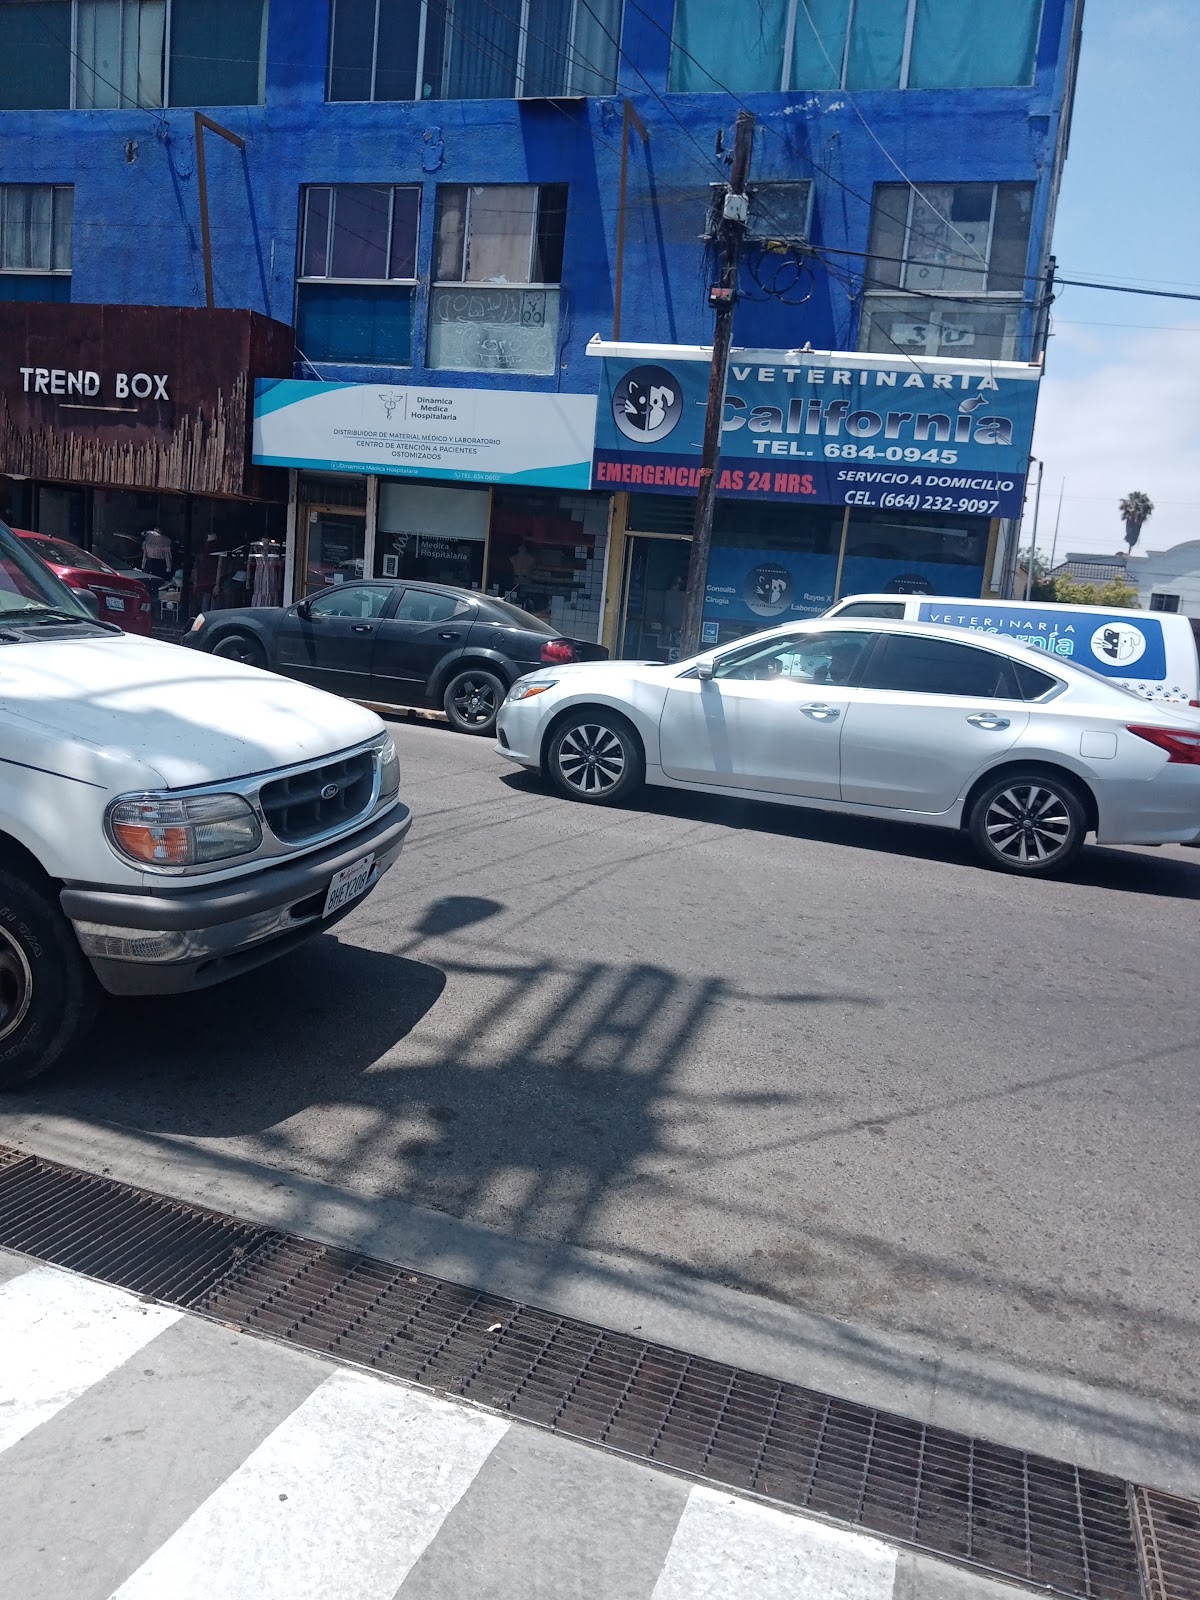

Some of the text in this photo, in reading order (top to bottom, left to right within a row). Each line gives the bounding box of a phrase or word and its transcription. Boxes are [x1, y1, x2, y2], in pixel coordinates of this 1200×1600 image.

[19, 367, 170, 401] TREND BOX
[731, 366, 1000, 391] VETERINARIA
[411, 411, 457, 421] Hospitalaria
[420, 404, 448, 412] Medica
[333, 428, 378, 438] DISTRIBUIDOR
[389, 432, 420, 440] MATERIAL
[421, 434, 448, 442] MÉDICO
[454, 437, 501, 446] LABORATORIO
[356, 440, 384, 448] CENTRO
[396, 443, 431, 452] ATENCIÓN
[439, 446, 478, 455] PACIENTES
[391, 450, 442, 461] OSTOMIZADOS
[752, 439, 959, 465] TEL. 684-0945
[597, 462, 817, 495] EMERGENCI AS 24 HRS.
[837, 470, 1015, 492] SERVICIO A DOMICILIO
[844, 490, 1000, 514] CEL. (664) 232-9097
[420, 549, 468, 560] Hospitalaria
[421, 541, 450, 550] Medica
[706, 584, 736, 594] Consulta
[803, 592, 825, 602] Rayos
[930, 614, 1076, 633] VETERINARIA
[327, 870, 368, 910] 8HEY208
